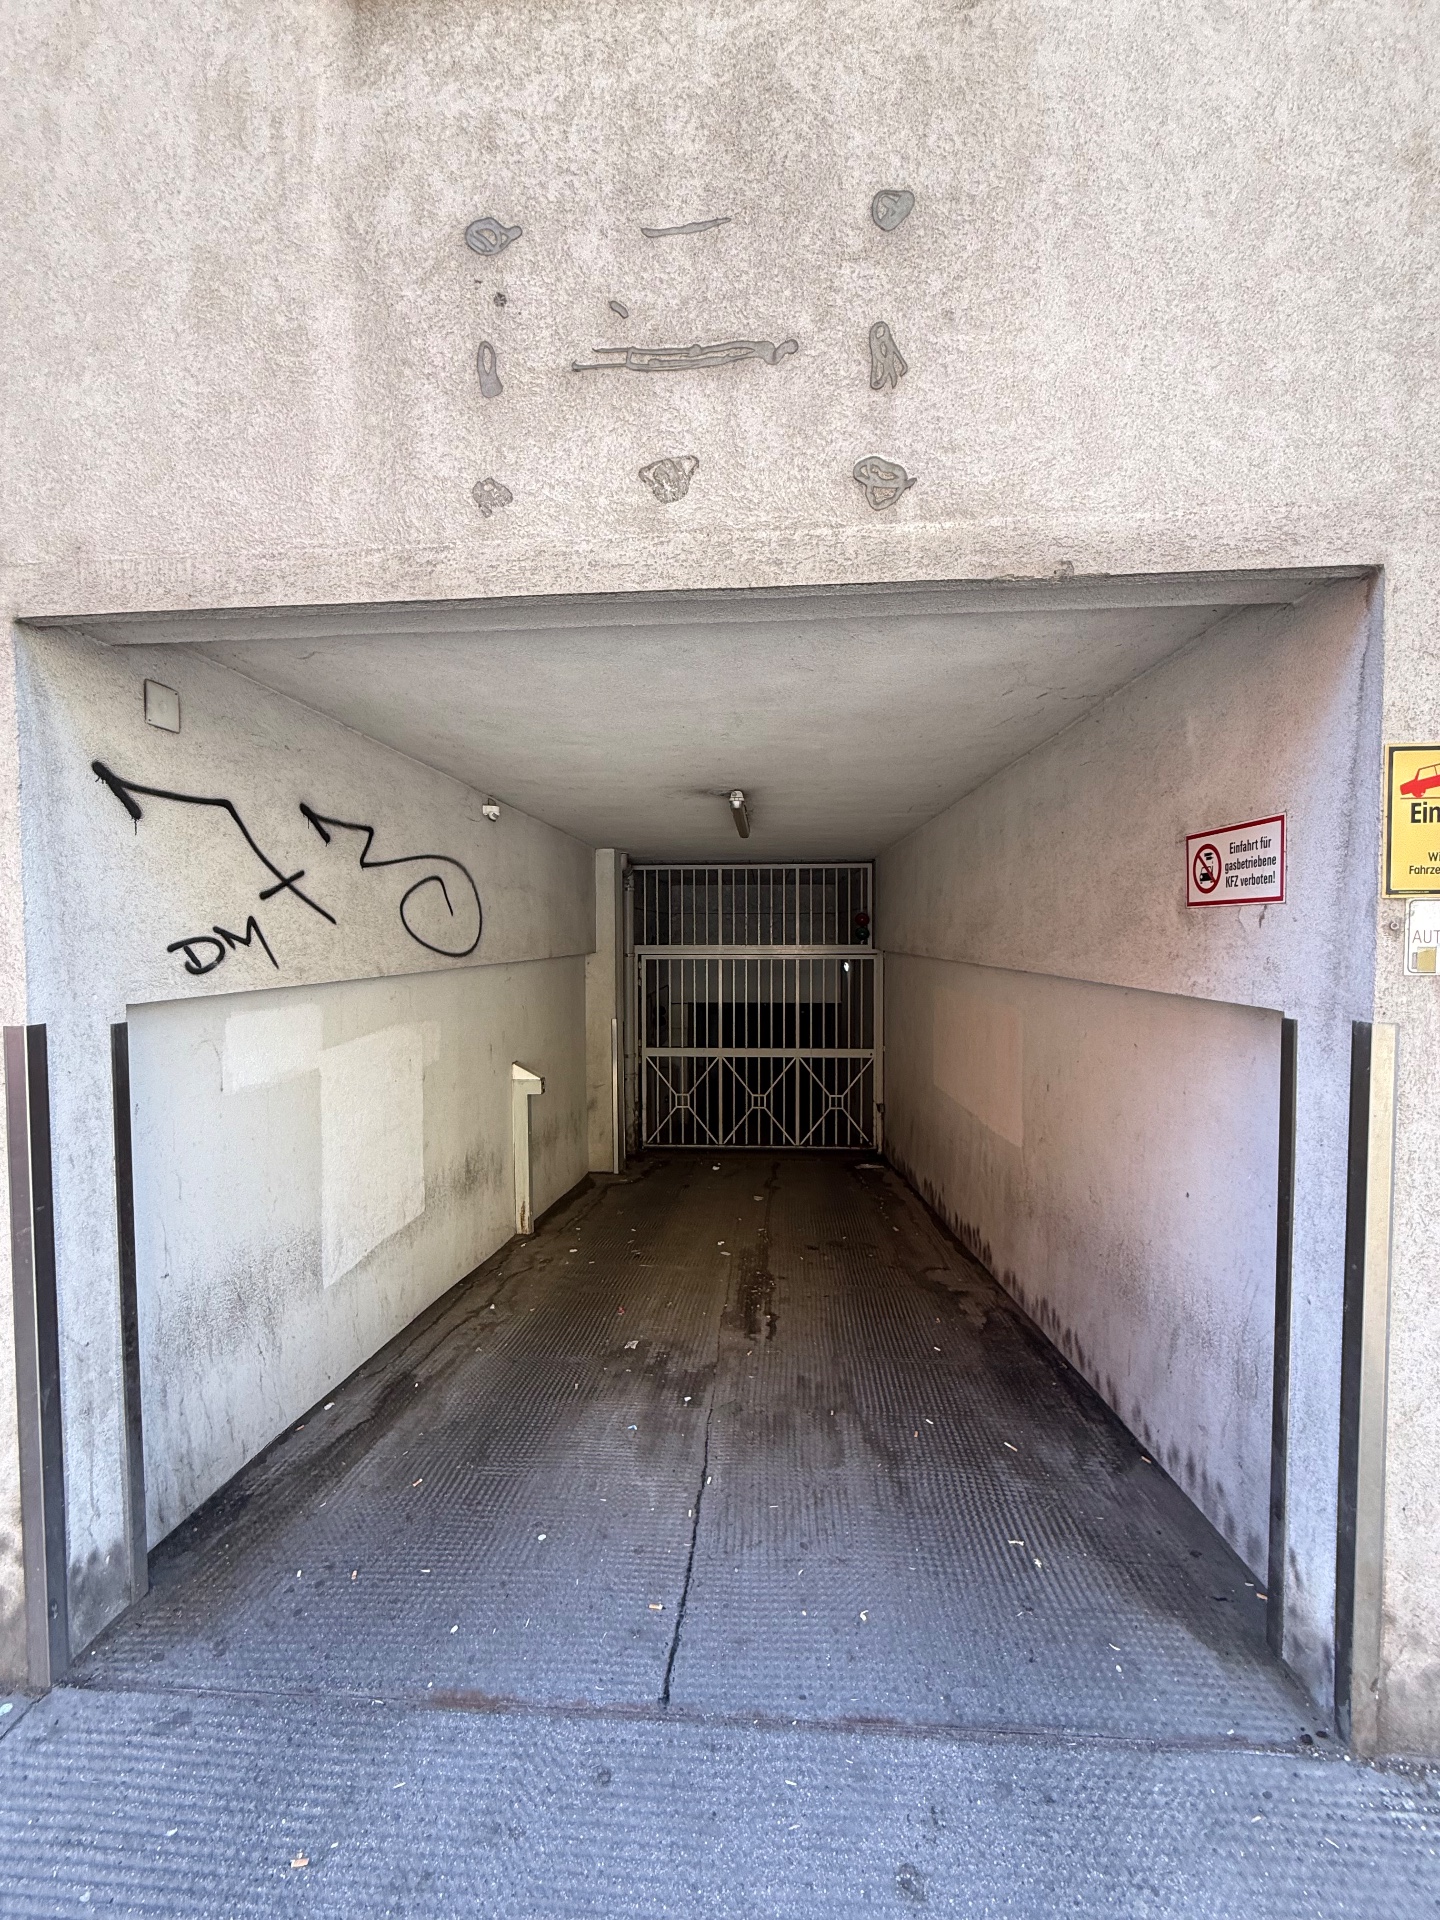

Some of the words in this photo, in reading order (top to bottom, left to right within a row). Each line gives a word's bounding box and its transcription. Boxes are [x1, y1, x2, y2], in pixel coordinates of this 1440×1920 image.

[1229, 839, 1259, 855] Einfahrt
[1260, 835, 1272, 850] für
[1225, 855, 1276, 874] gasbetriebene
[1225, 874, 1239, 888] KFZ
[1240, 870, 1275, 886] verboten!
[1412, 930, 1440, 943] AUT
